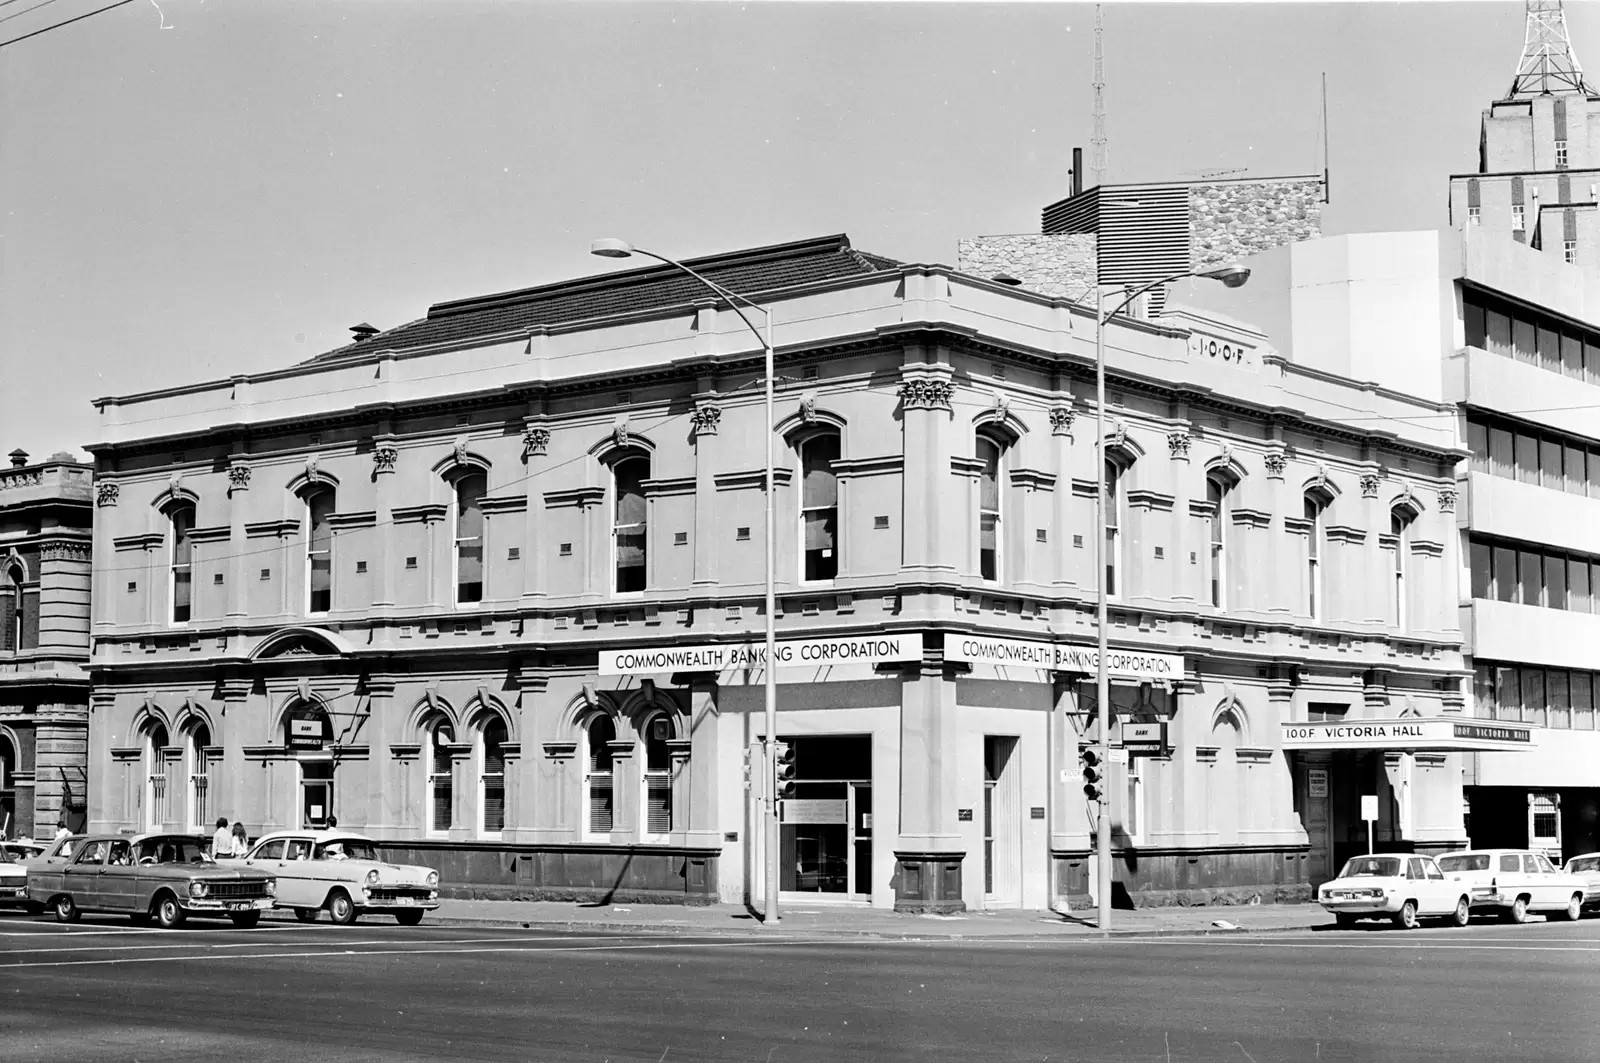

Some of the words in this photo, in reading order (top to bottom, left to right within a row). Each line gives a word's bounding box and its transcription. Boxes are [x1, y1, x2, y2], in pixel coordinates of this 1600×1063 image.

[616, 650, 723, 670] COMMONWEALTH
[731, 646, 793, 664] BANKNG
[800, 640, 900, 661] CORPORATION
[962, 640, 1051, 662] COMMONWEALTH
[1055, 651, 1100, 668] BANKING
[1325, 726, 1387, 738] VICTORIA
[1392, 726, 1424, 737] HALL
[1476, 727, 1510, 738] VICTORIA
